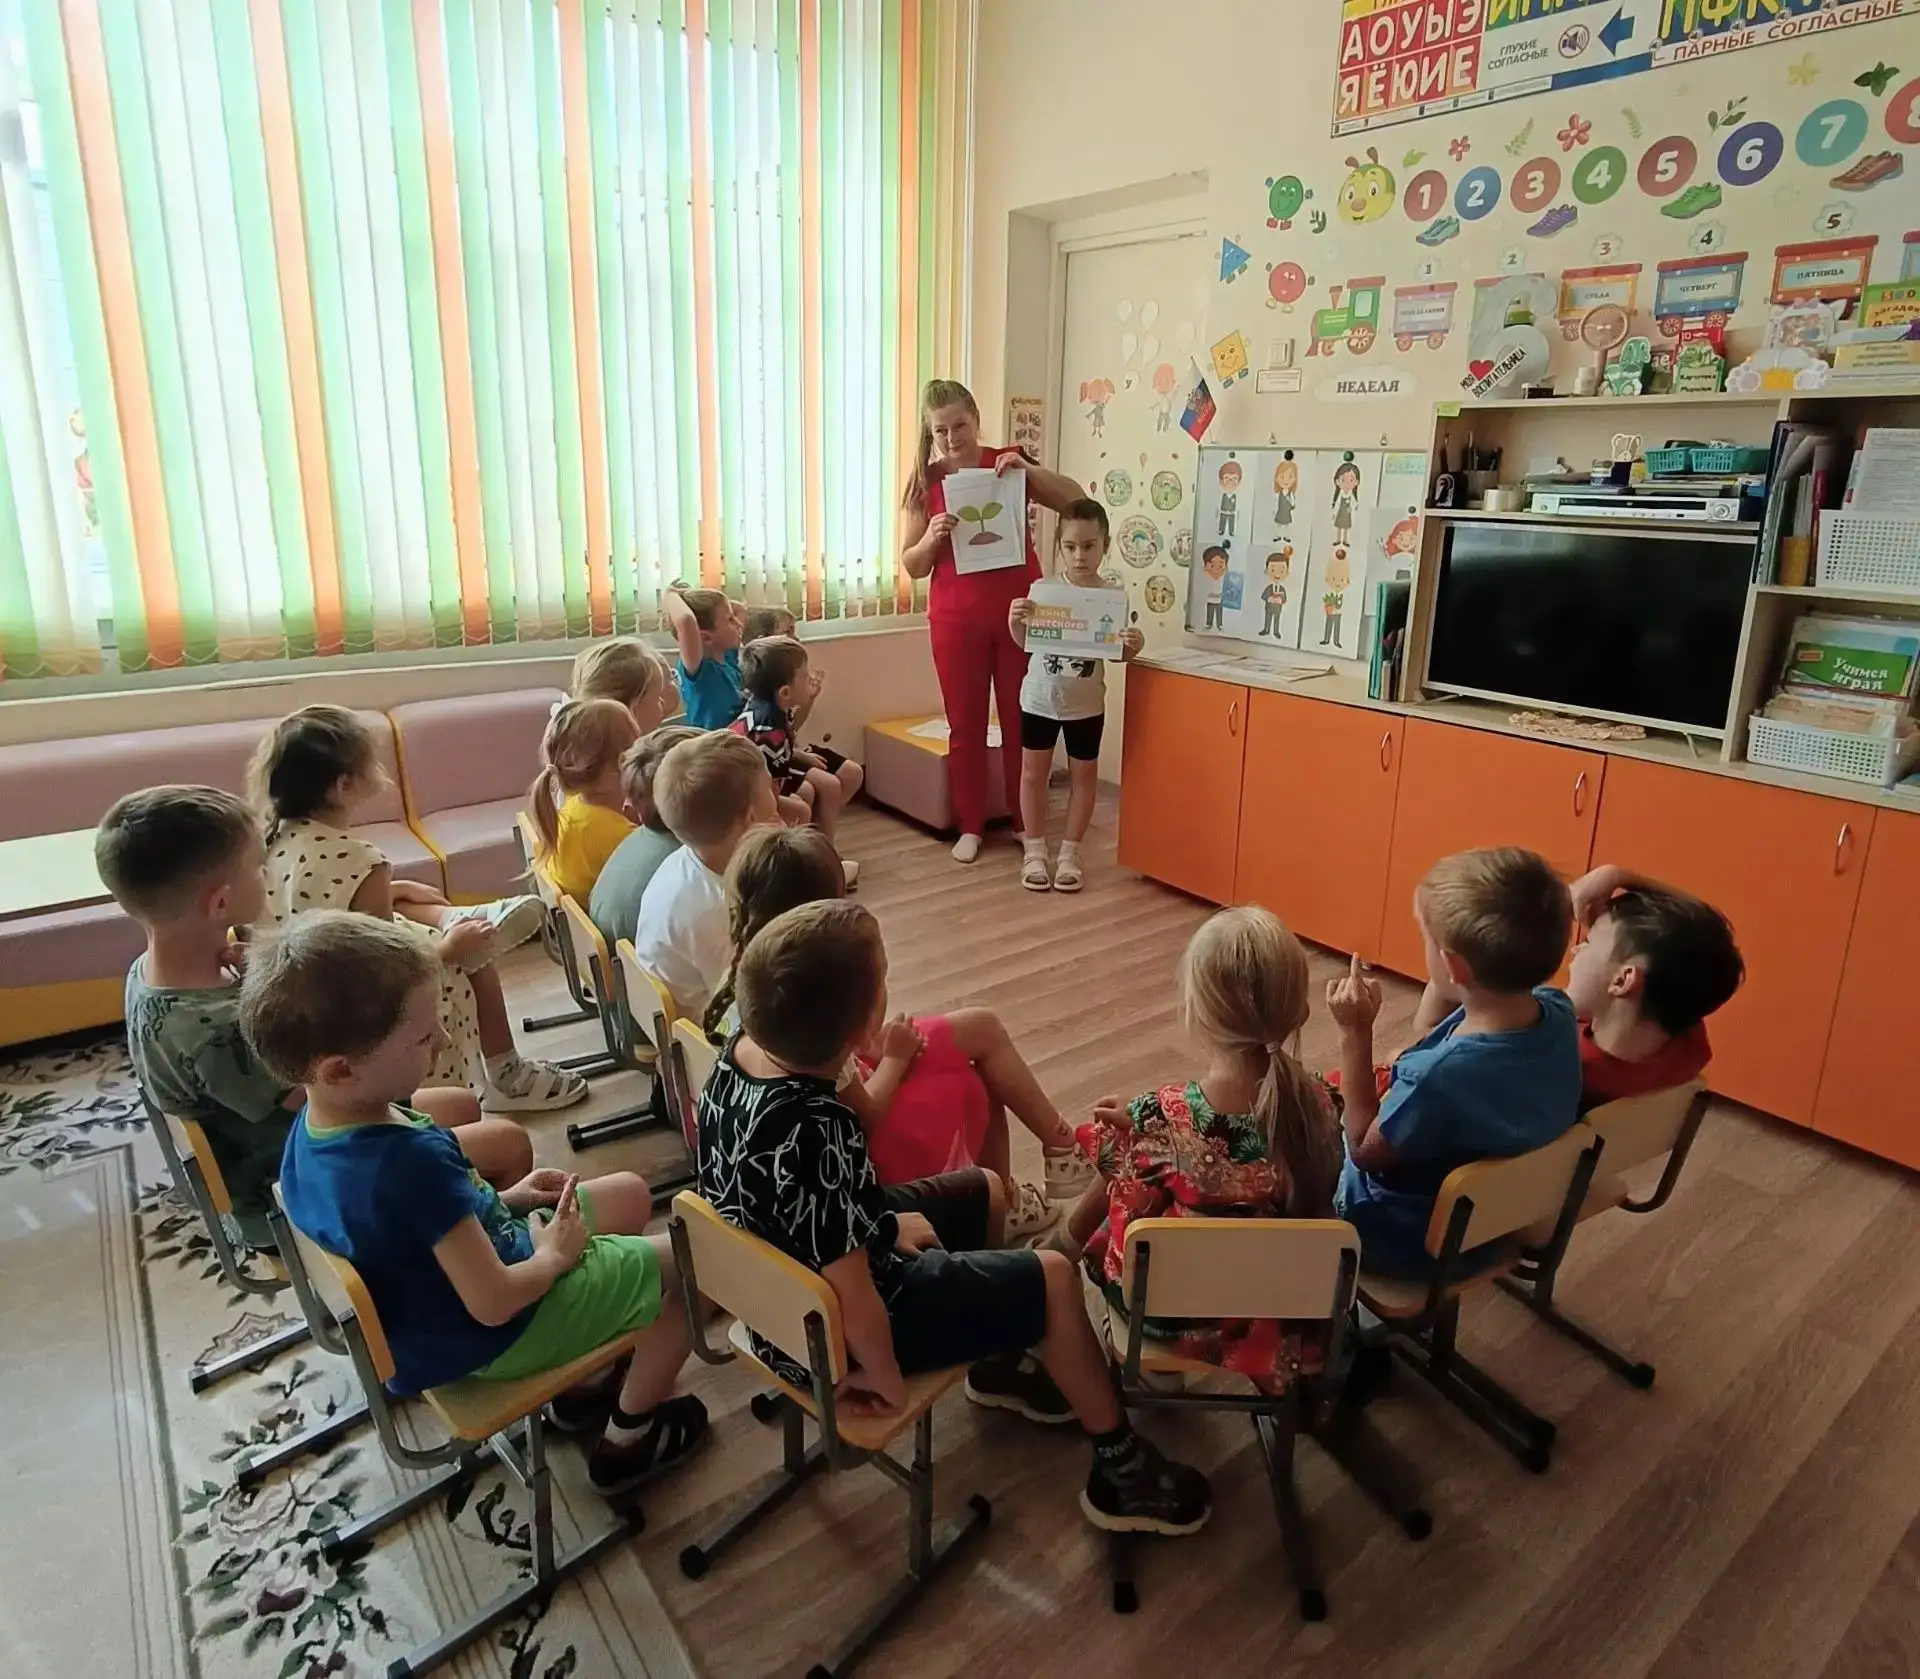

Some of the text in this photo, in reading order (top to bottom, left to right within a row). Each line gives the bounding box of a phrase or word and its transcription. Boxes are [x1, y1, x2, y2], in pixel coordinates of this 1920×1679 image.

[1674, 0, 1903, 60] ПАРНЫЕ СОГЛАСНЫЕ
[1500, 39, 1538, 56] ГЛУХИЕ
[1488, 48, 1549, 70] СОГЛАСНЫЕ
[1419, 184, 1431, 209] 1
[1467, 180, 1485, 207] 2
[1525, 170, 1545, 199] 3
[1586, 160, 1612, 189] 4
[1655, 150, 1679, 182] 5
[1736, 138, 1763, 171] 6
[1820, 115, 1847, 149] 7
[1507, 254, 1517, 265] 2
[1600, 242, 1611, 256] 3
[1700, 229, 1713, 245] 4
[1826, 213, 1842, 229] 5
[1797, 268, 1845, 280] ПЯТНИЦА
[1680, 282, 1718, 293] ЧЕТВЕРГ
[1336, 380, 1400, 394] НЕДЕЛЯ
[1031, 628, 1058, 639] сада
[1833, 657, 1889, 679] Учимся
[1832, 672, 1883, 690] играя
